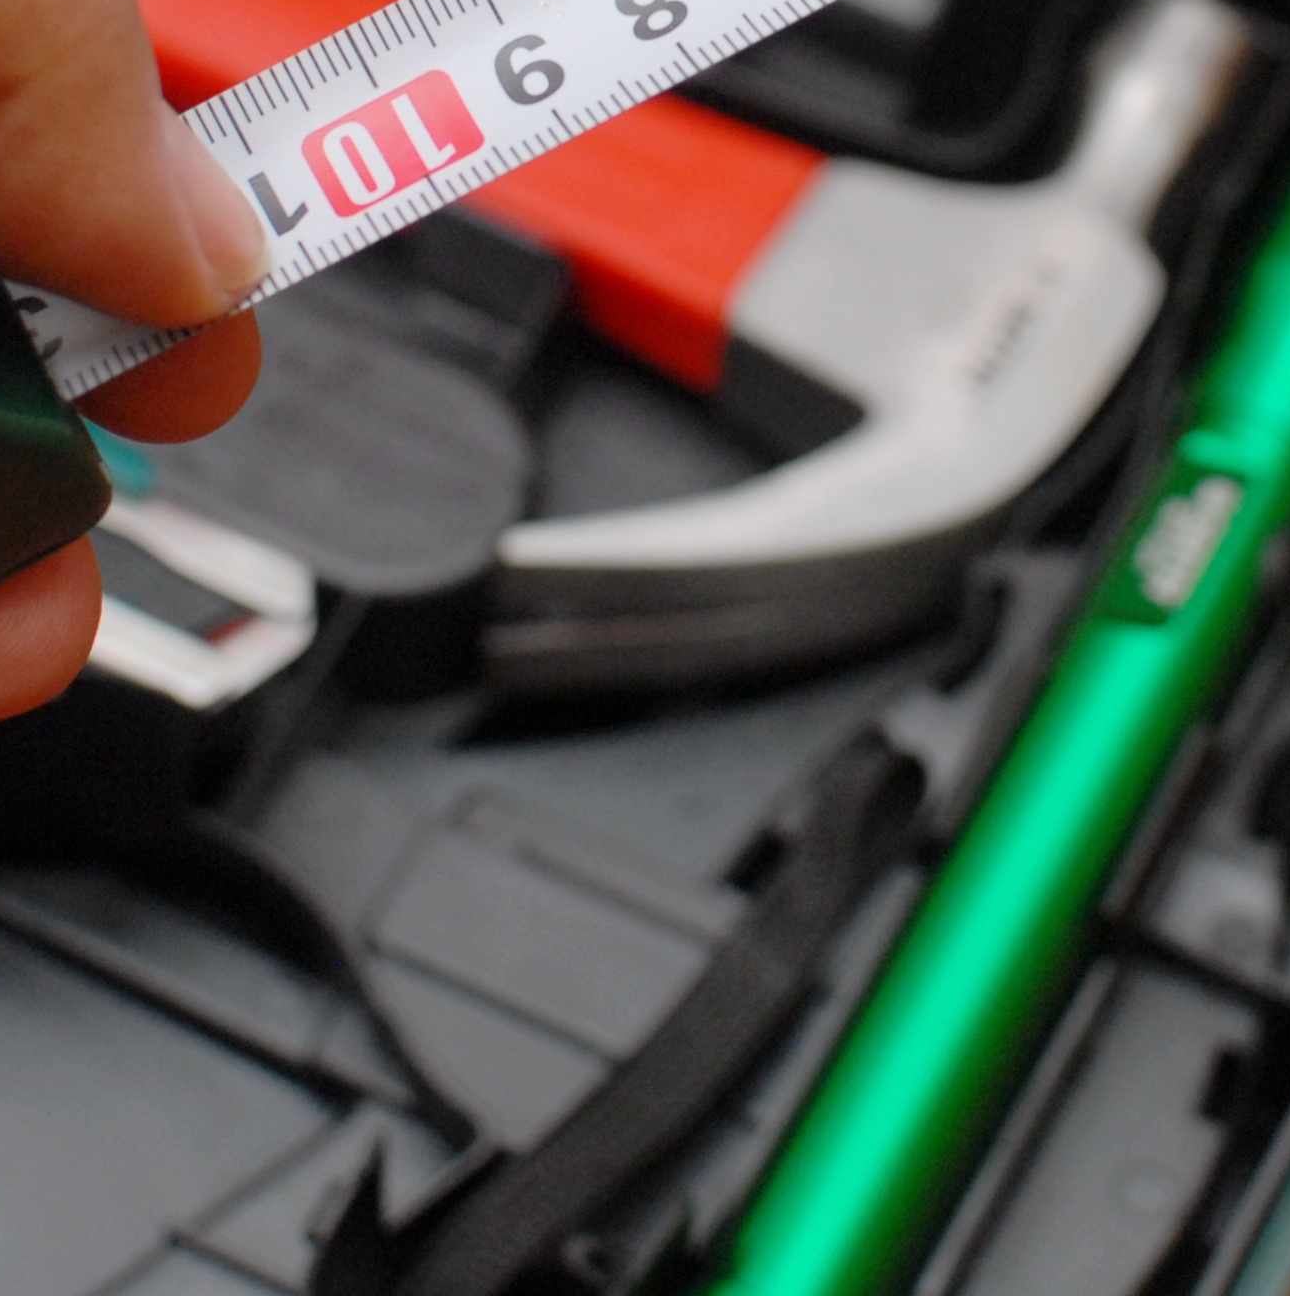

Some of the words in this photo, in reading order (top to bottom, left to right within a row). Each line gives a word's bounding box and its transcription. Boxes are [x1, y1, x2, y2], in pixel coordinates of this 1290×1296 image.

[494, 33, 566, 105] 9
[322, 93, 457, 206] 10
[248, 170, 309, 237] 1
